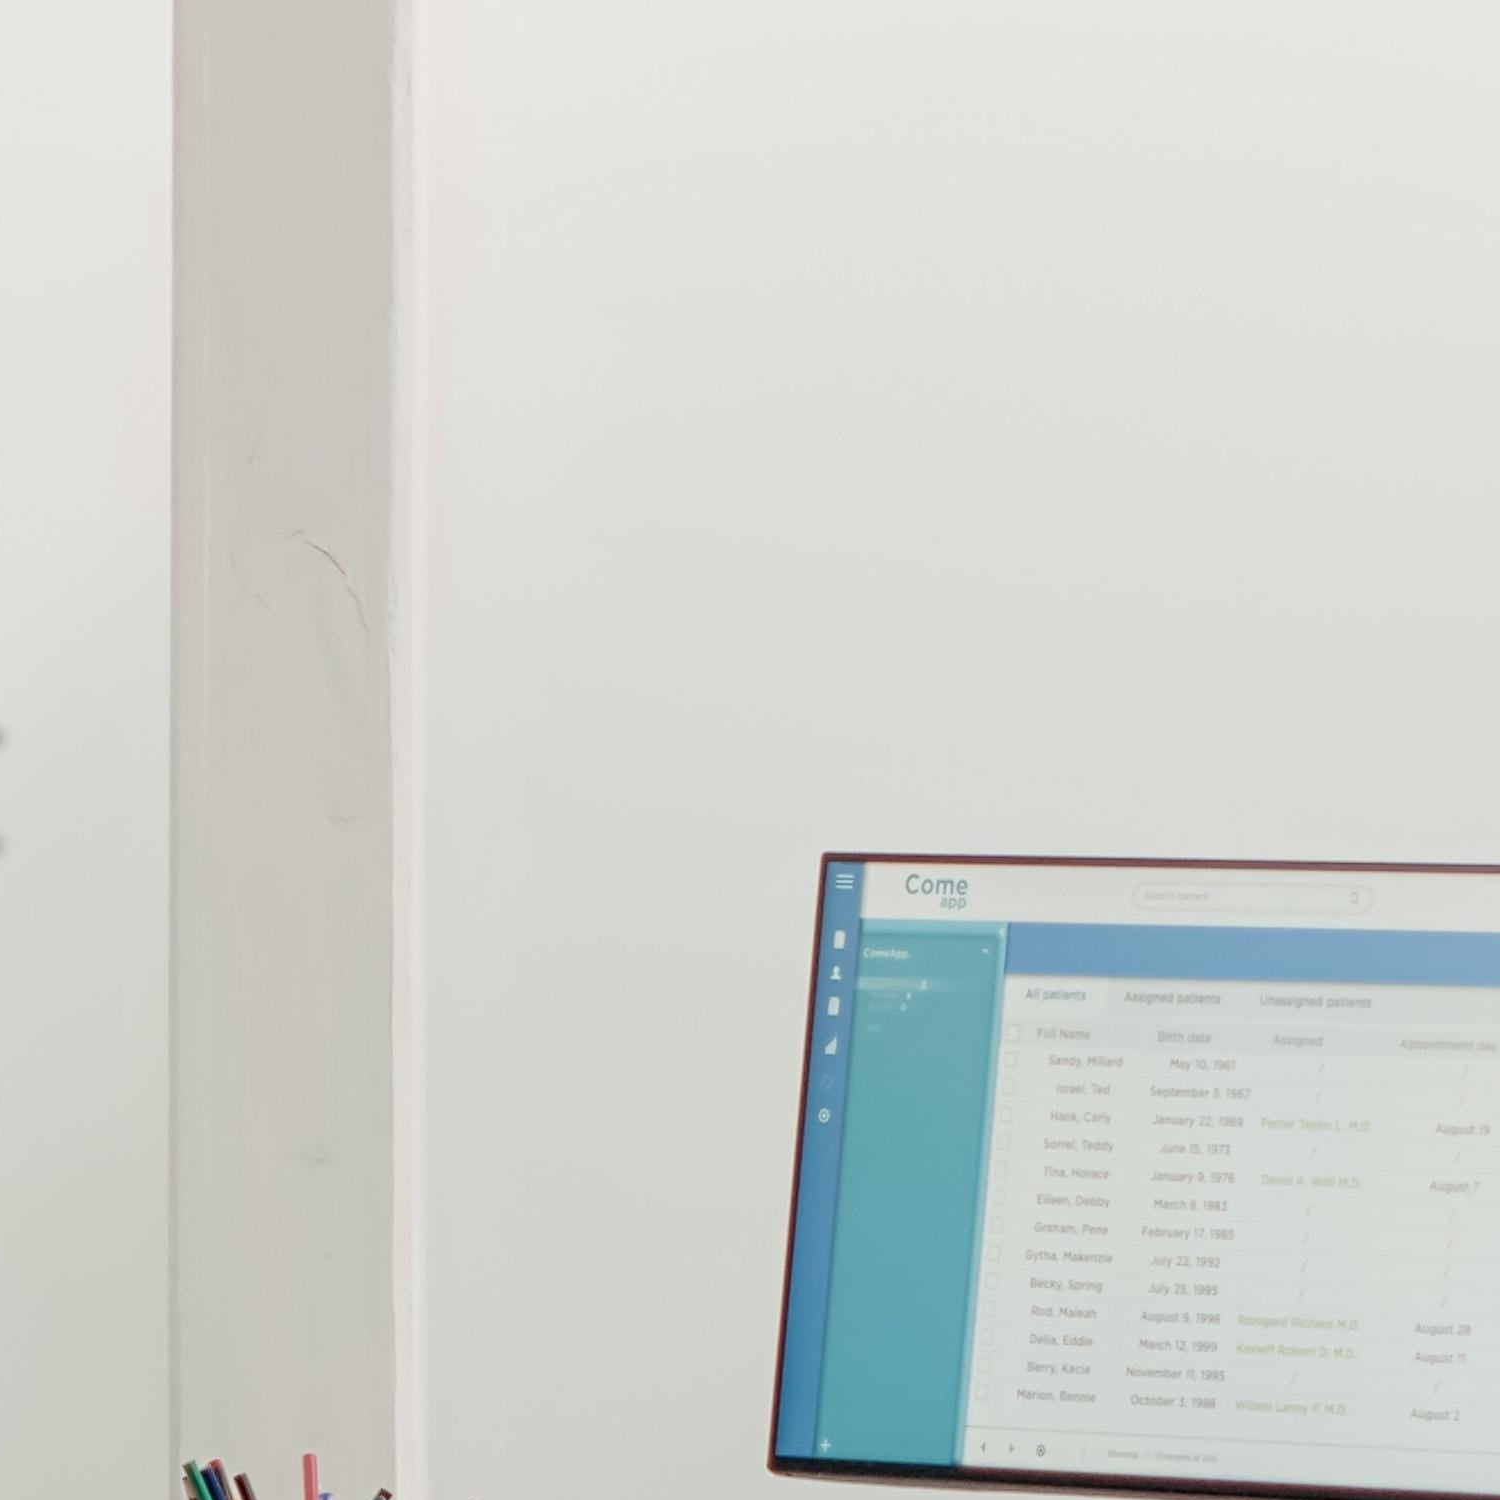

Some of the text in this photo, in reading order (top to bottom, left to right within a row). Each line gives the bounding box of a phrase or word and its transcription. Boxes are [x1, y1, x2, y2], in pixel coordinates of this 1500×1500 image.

[905, 874, 968, 895] Come
[940, 897, 967, 910] app
[1025, 988, 1087, 1002] All patients
[1124, 991, 1220, 1005] Assigned patients
[1260, 994, 1372, 1009] Unassigned patients
[1037, 1028, 1091, 1040] Full Name
[1157, 1030, 1212, 1044] Birth date
[1272, 1035, 1324, 1048] Assigned
[1048, 1054, 1082, 1068] Sandy,
[1170, 1058, 1191, 1071] May
[1092, 1084, 1111, 1095] Ted
[1150, 1085, 1210, 1098] September
[1152, 1114, 1195, 1128] January
[1436, 1123, 1475, 1136] August
[1082, 1140, 1114, 1152] Teddy
[1159, 1144, 1186, 1154] June
[1071, 1168, 1109, 1179] Horace
[1150, 1170, 1194, 1184] January
[1429, 1181, 1468, 1194] August
[1153, 1198, 1186, 1210] March
[1140, 1225, 1190, 1240] February
[1150, 1255, 1173, 1268] July
[1196, 1256, 1220, 1268] 1992
[1067, 1279, 1103, 1293] Spring
[1148, 1282, 1170, 1295] July
[1194, 1284, 1218, 1296] 1995
[1140, 1311, 1179, 1324] August
[1414, 1323, 1453, 1336] August
[1062, 1335, 1093, 1347] Eddie
[1139, 1338, 1172, 1351] March
[1414, 1352, 1453, 1365] August
[1125, 1366, 1182, 1379] November
[1201, 1369, 1226, 1381] 1995
[1130, 1394, 1174, 1406] October
[1411, 1408, 1450, 1422] August
